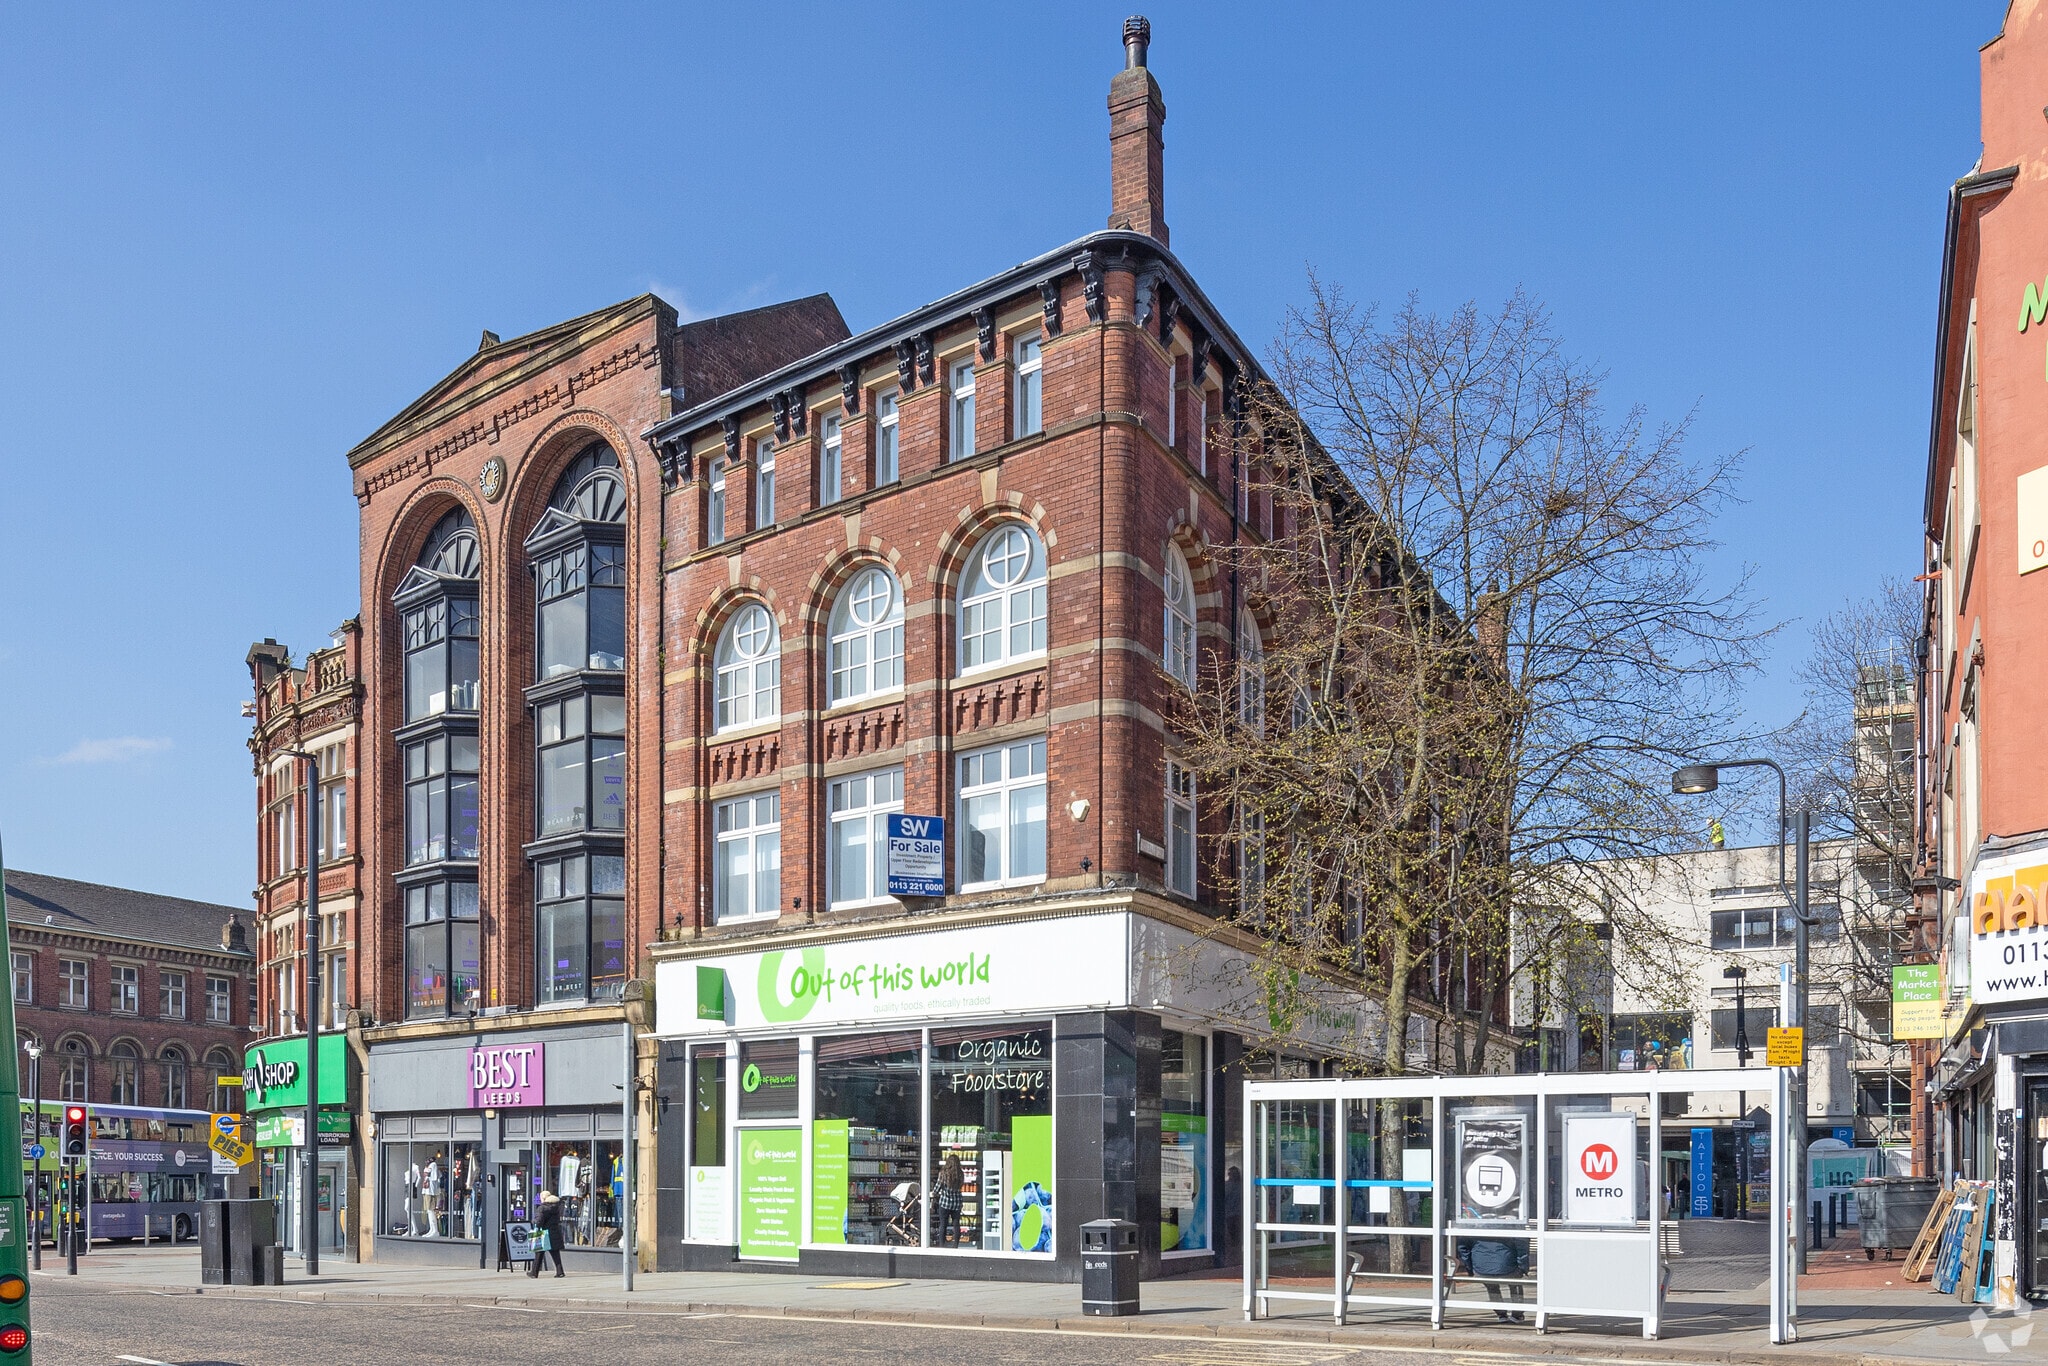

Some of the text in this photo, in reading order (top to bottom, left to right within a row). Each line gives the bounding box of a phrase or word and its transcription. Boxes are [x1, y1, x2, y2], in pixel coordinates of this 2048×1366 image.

[900, 817, 930, 837] SW
[891, 840, 941, 853] For Sale
[889, 881, 944, 891] 0113 221 6000
[790, 952, 990, 1002] Out of this world
[1906, 969, 1928, 978] The
[1897, 980, 1938, 989] Market
[1903, 991, 1932, 1000] Place
[873, 996, 991, 1014] quality foods, ethically traded
[958, 1033, 1042, 1065] Organic
[265, 1061, 295, 1087] SHOP
[472, 1047, 534, 1089] BEST
[951, 1067, 1045, 1094] Foodstore
[483, 1091, 521, 1104] LEEDS
[213, 1134, 246, 1158] PIES
[114, 1152, 134, 1161] YOUR
[134, 1153, 165, 1162] SUCCESS.
[1585, 1151, 1613, 1173] M
[1575, 1187, 1623, 1198] METRO
